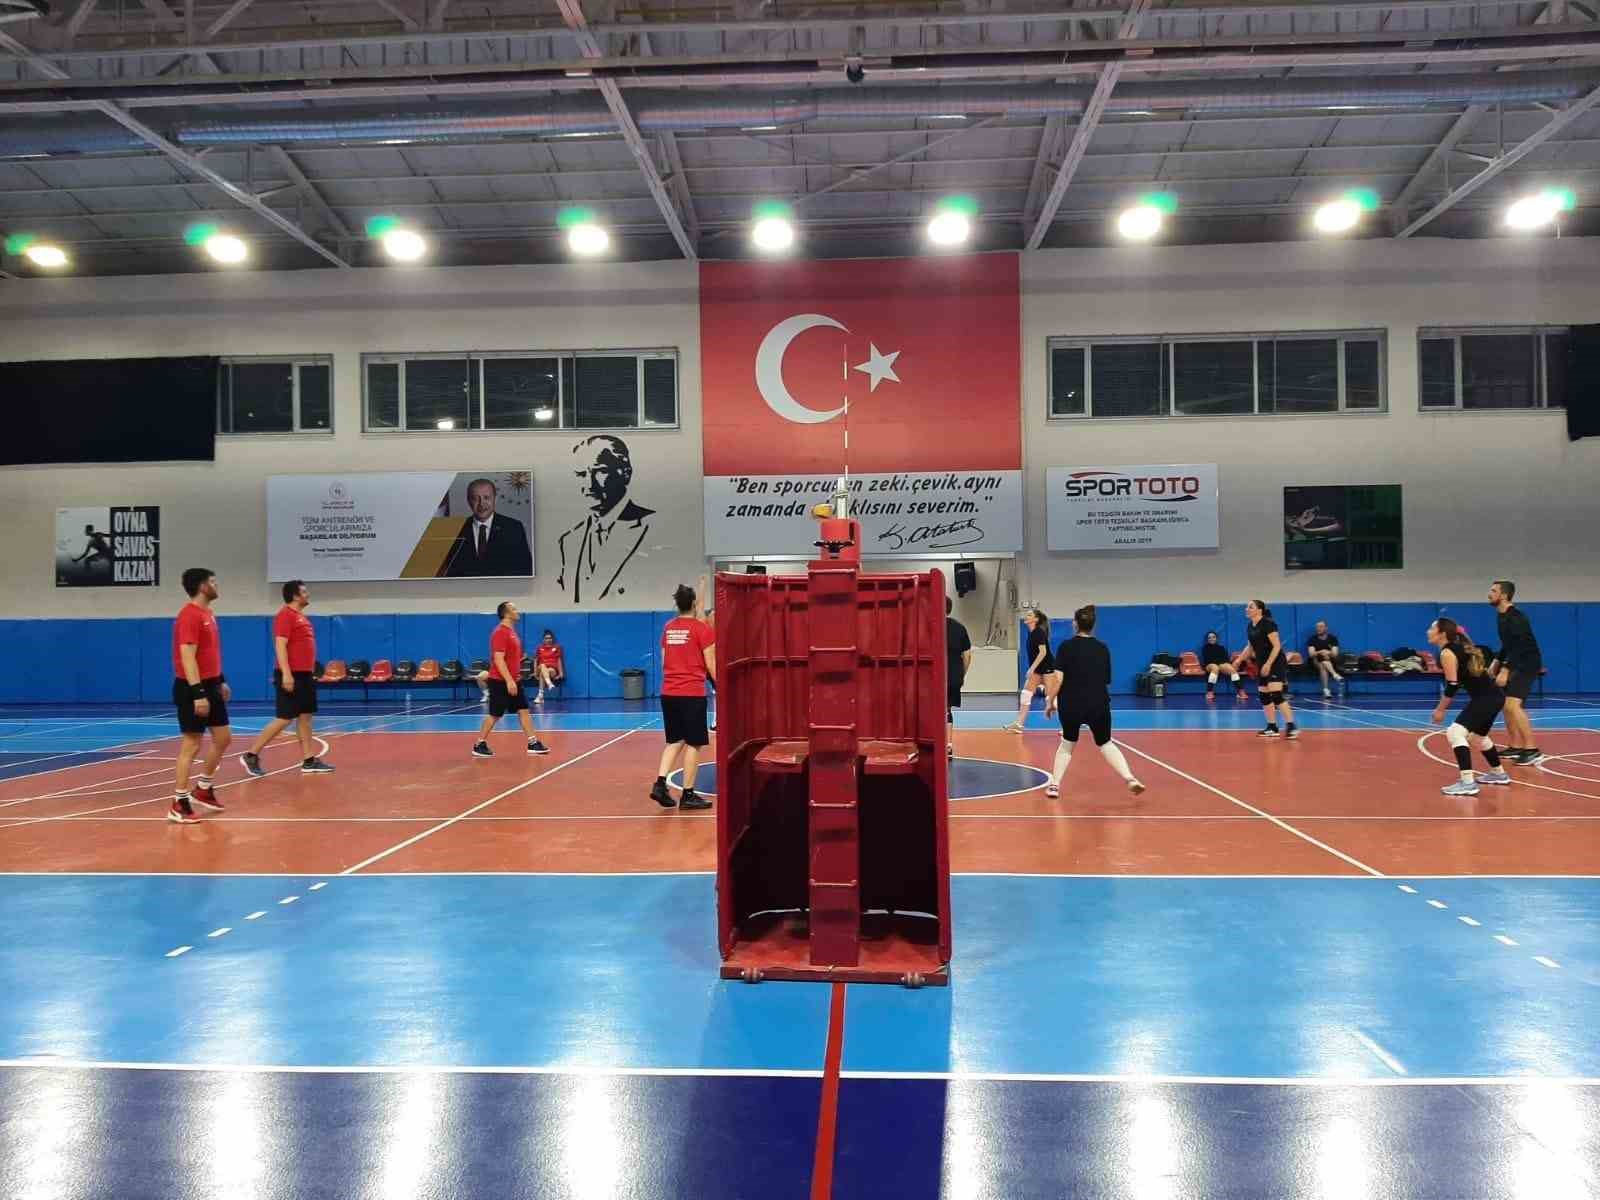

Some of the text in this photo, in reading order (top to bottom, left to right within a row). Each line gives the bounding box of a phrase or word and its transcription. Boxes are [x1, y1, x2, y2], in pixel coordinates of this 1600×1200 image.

[726, 500, 806, 517] zamanda
[114, 511, 148, 532] OYNA
[114, 560, 155, 582] KAZAN
